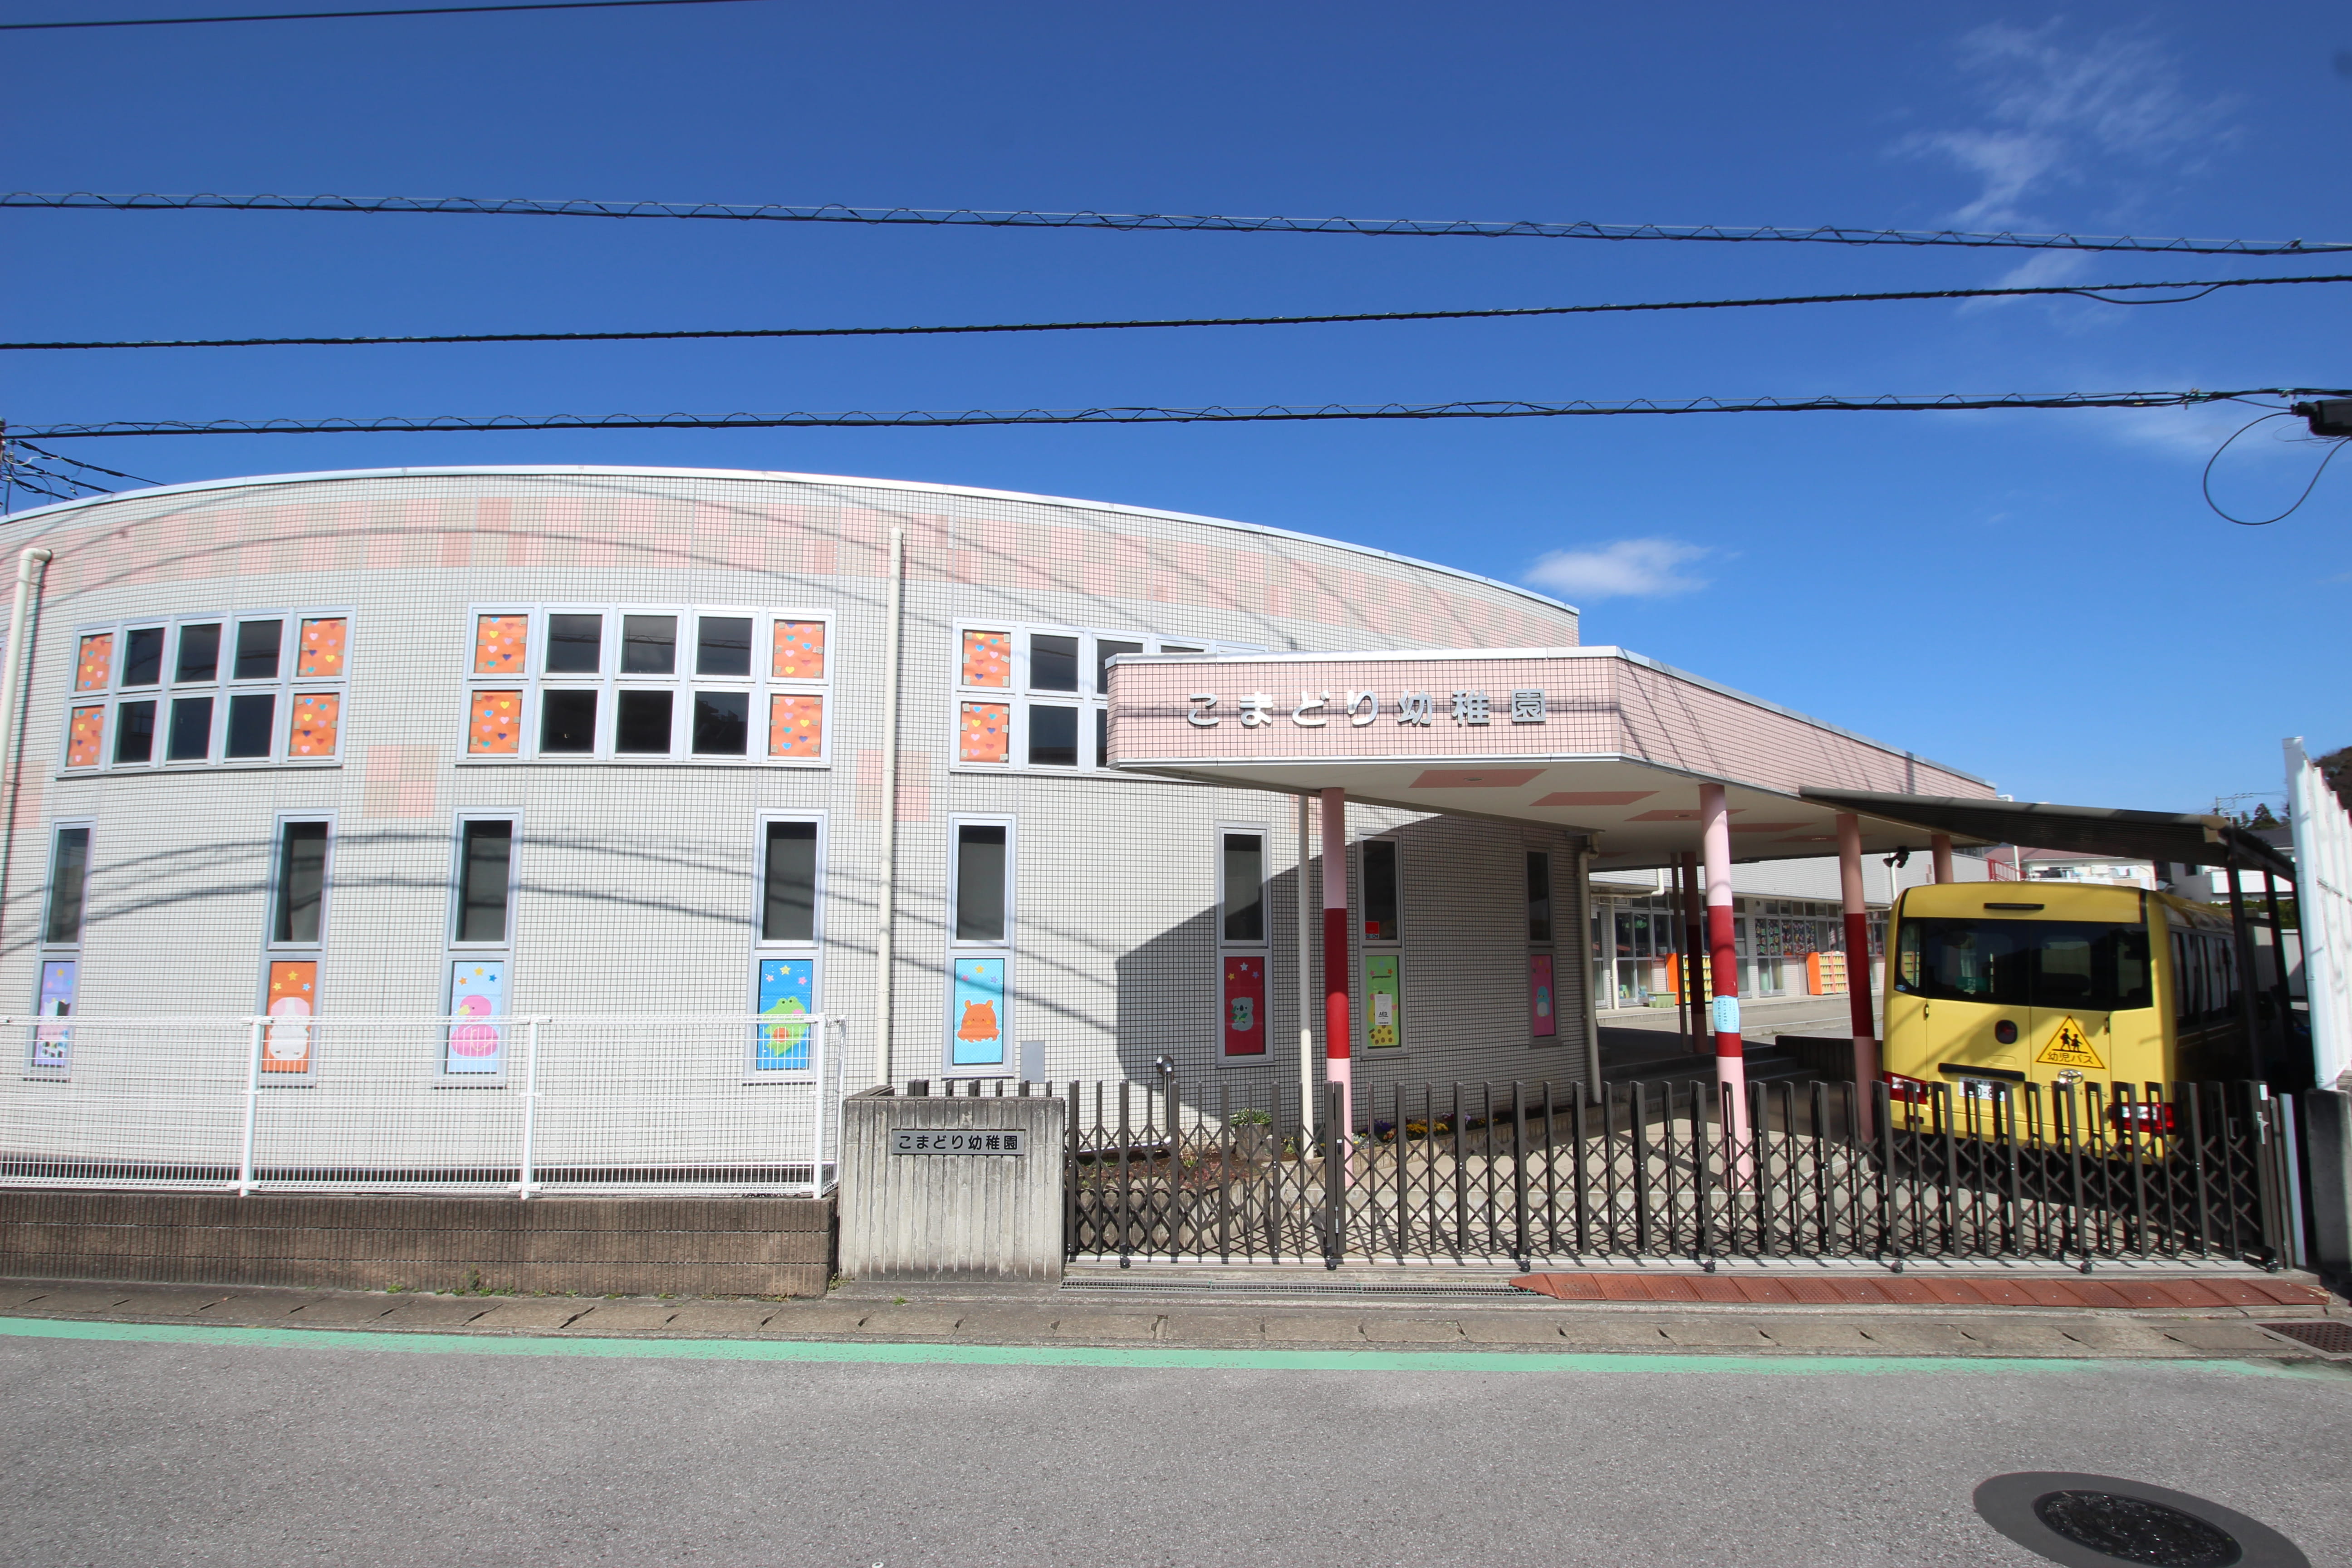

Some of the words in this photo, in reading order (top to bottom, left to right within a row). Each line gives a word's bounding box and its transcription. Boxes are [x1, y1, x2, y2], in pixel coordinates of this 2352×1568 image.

[1187, 688, 1547, 729] こまどり幼稚園
[2047, 1052, 2094, 1064] 幼児バス
[899, 1135, 1018, 1150] こまどり幼稚園
